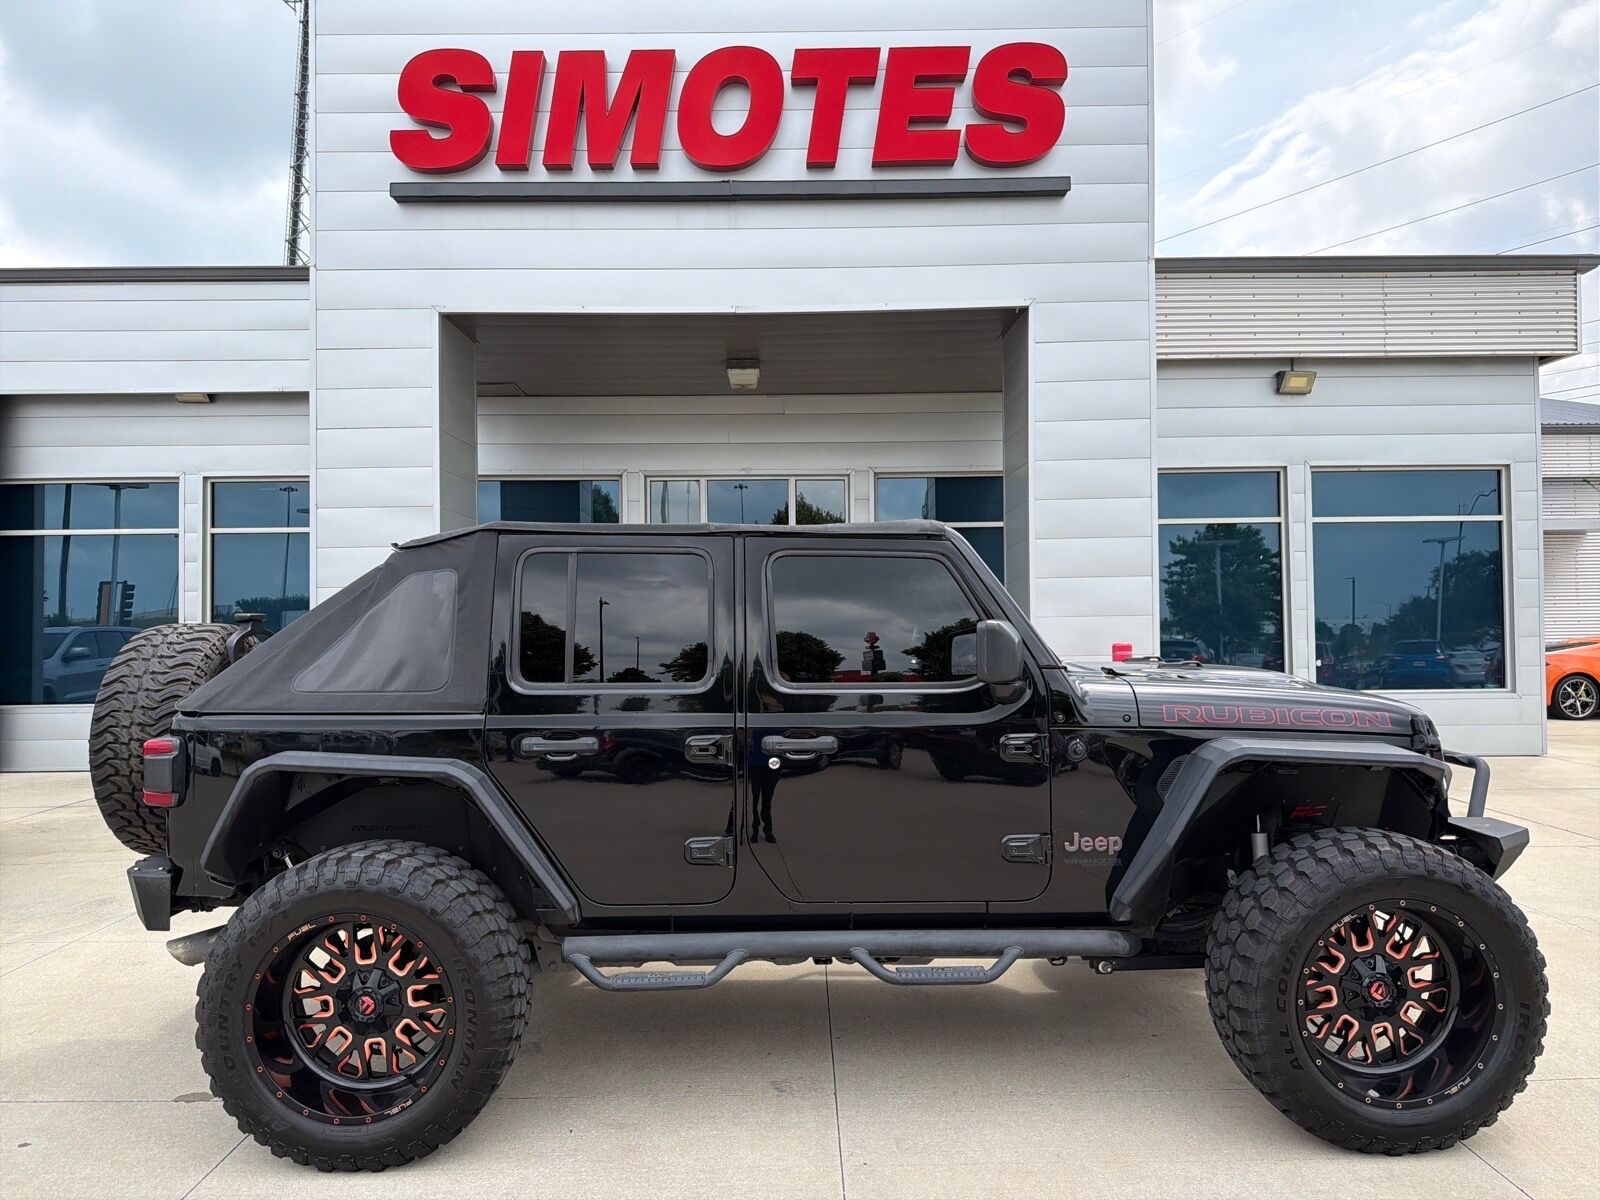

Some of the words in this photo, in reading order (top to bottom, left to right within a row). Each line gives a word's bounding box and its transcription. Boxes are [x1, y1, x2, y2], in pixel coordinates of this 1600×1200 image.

[390, 42, 1067, 174] SIMOTES
[1163, 705, 1392, 728] RUBICON
[1064, 831, 1122, 856] Jeep
[287, 923, 316, 941] FUEL
[1330, 914, 1357, 932] FUEL
[450, 955, 478, 1089] IRONMAN
[1277, 1023, 1305, 1072] ALL
[1443, 1077, 1471, 1097] FUEL
[384, 1098, 412, 1116] FUEL
